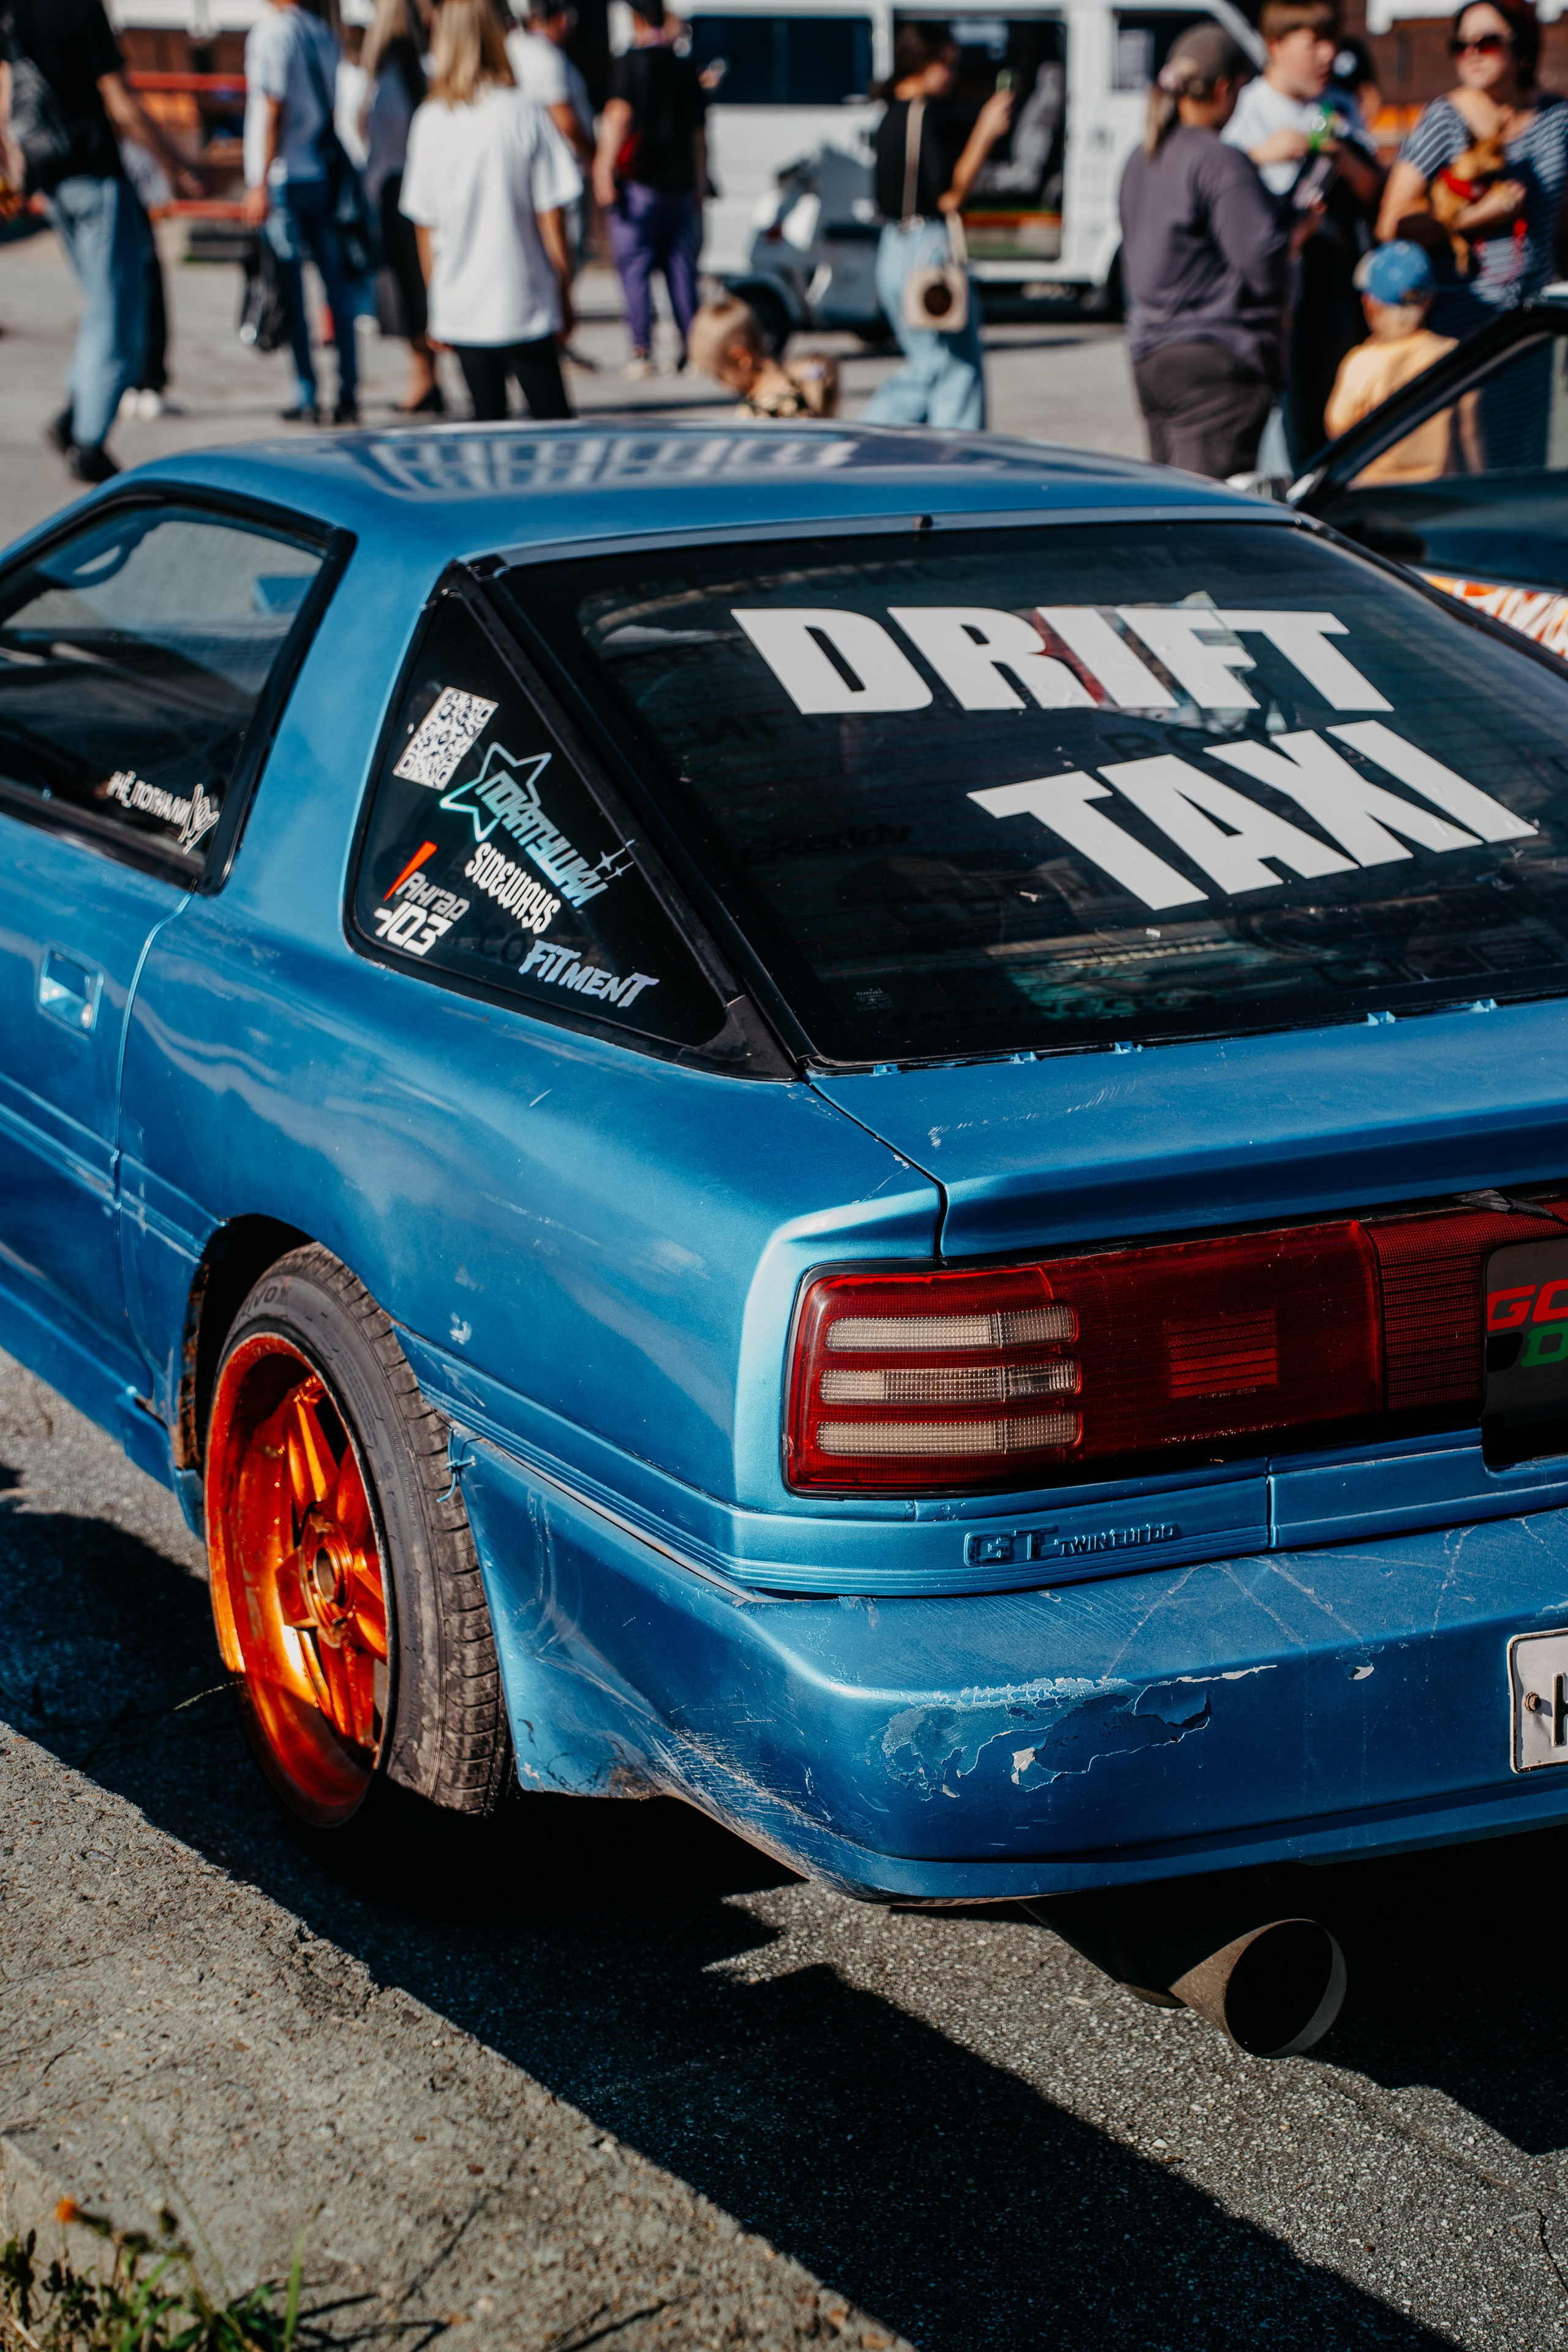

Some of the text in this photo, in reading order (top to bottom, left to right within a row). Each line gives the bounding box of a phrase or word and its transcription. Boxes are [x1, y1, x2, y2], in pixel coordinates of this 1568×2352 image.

[731, 607, 1394, 712] DRIFT
[475, 769, 609, 908] ПОКАТУШКИ
[967, 719, 1539, 911] TAXI
[464, 842, 562, 935] SIDEWAYS
[518, 939, 660, 1008] FITMENT
[963, 1523, 1059, 1567] GT
